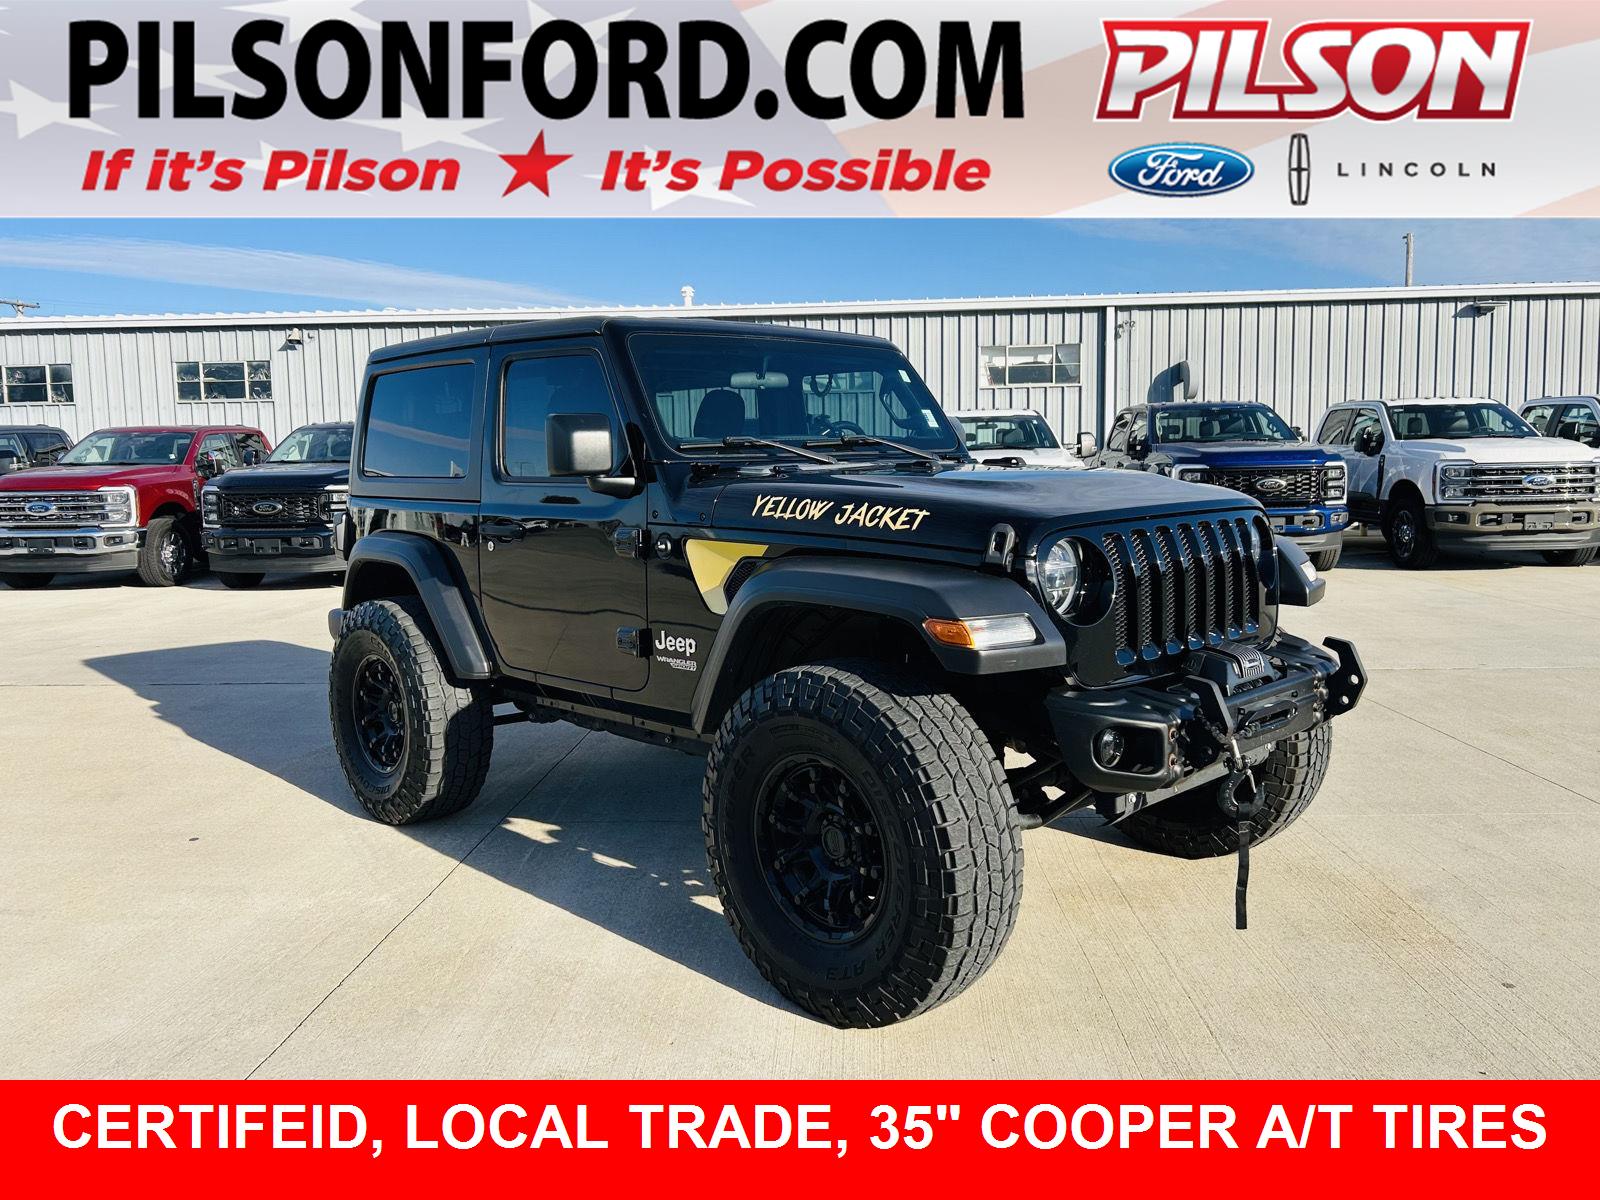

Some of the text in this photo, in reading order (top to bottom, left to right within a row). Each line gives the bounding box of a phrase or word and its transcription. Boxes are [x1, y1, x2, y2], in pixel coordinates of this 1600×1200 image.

[751, 494, 931, 531] YELLOW JACKET
[654, 630, 697, 657] Jeep
[656, 655, 697, 667] WRANGLER
